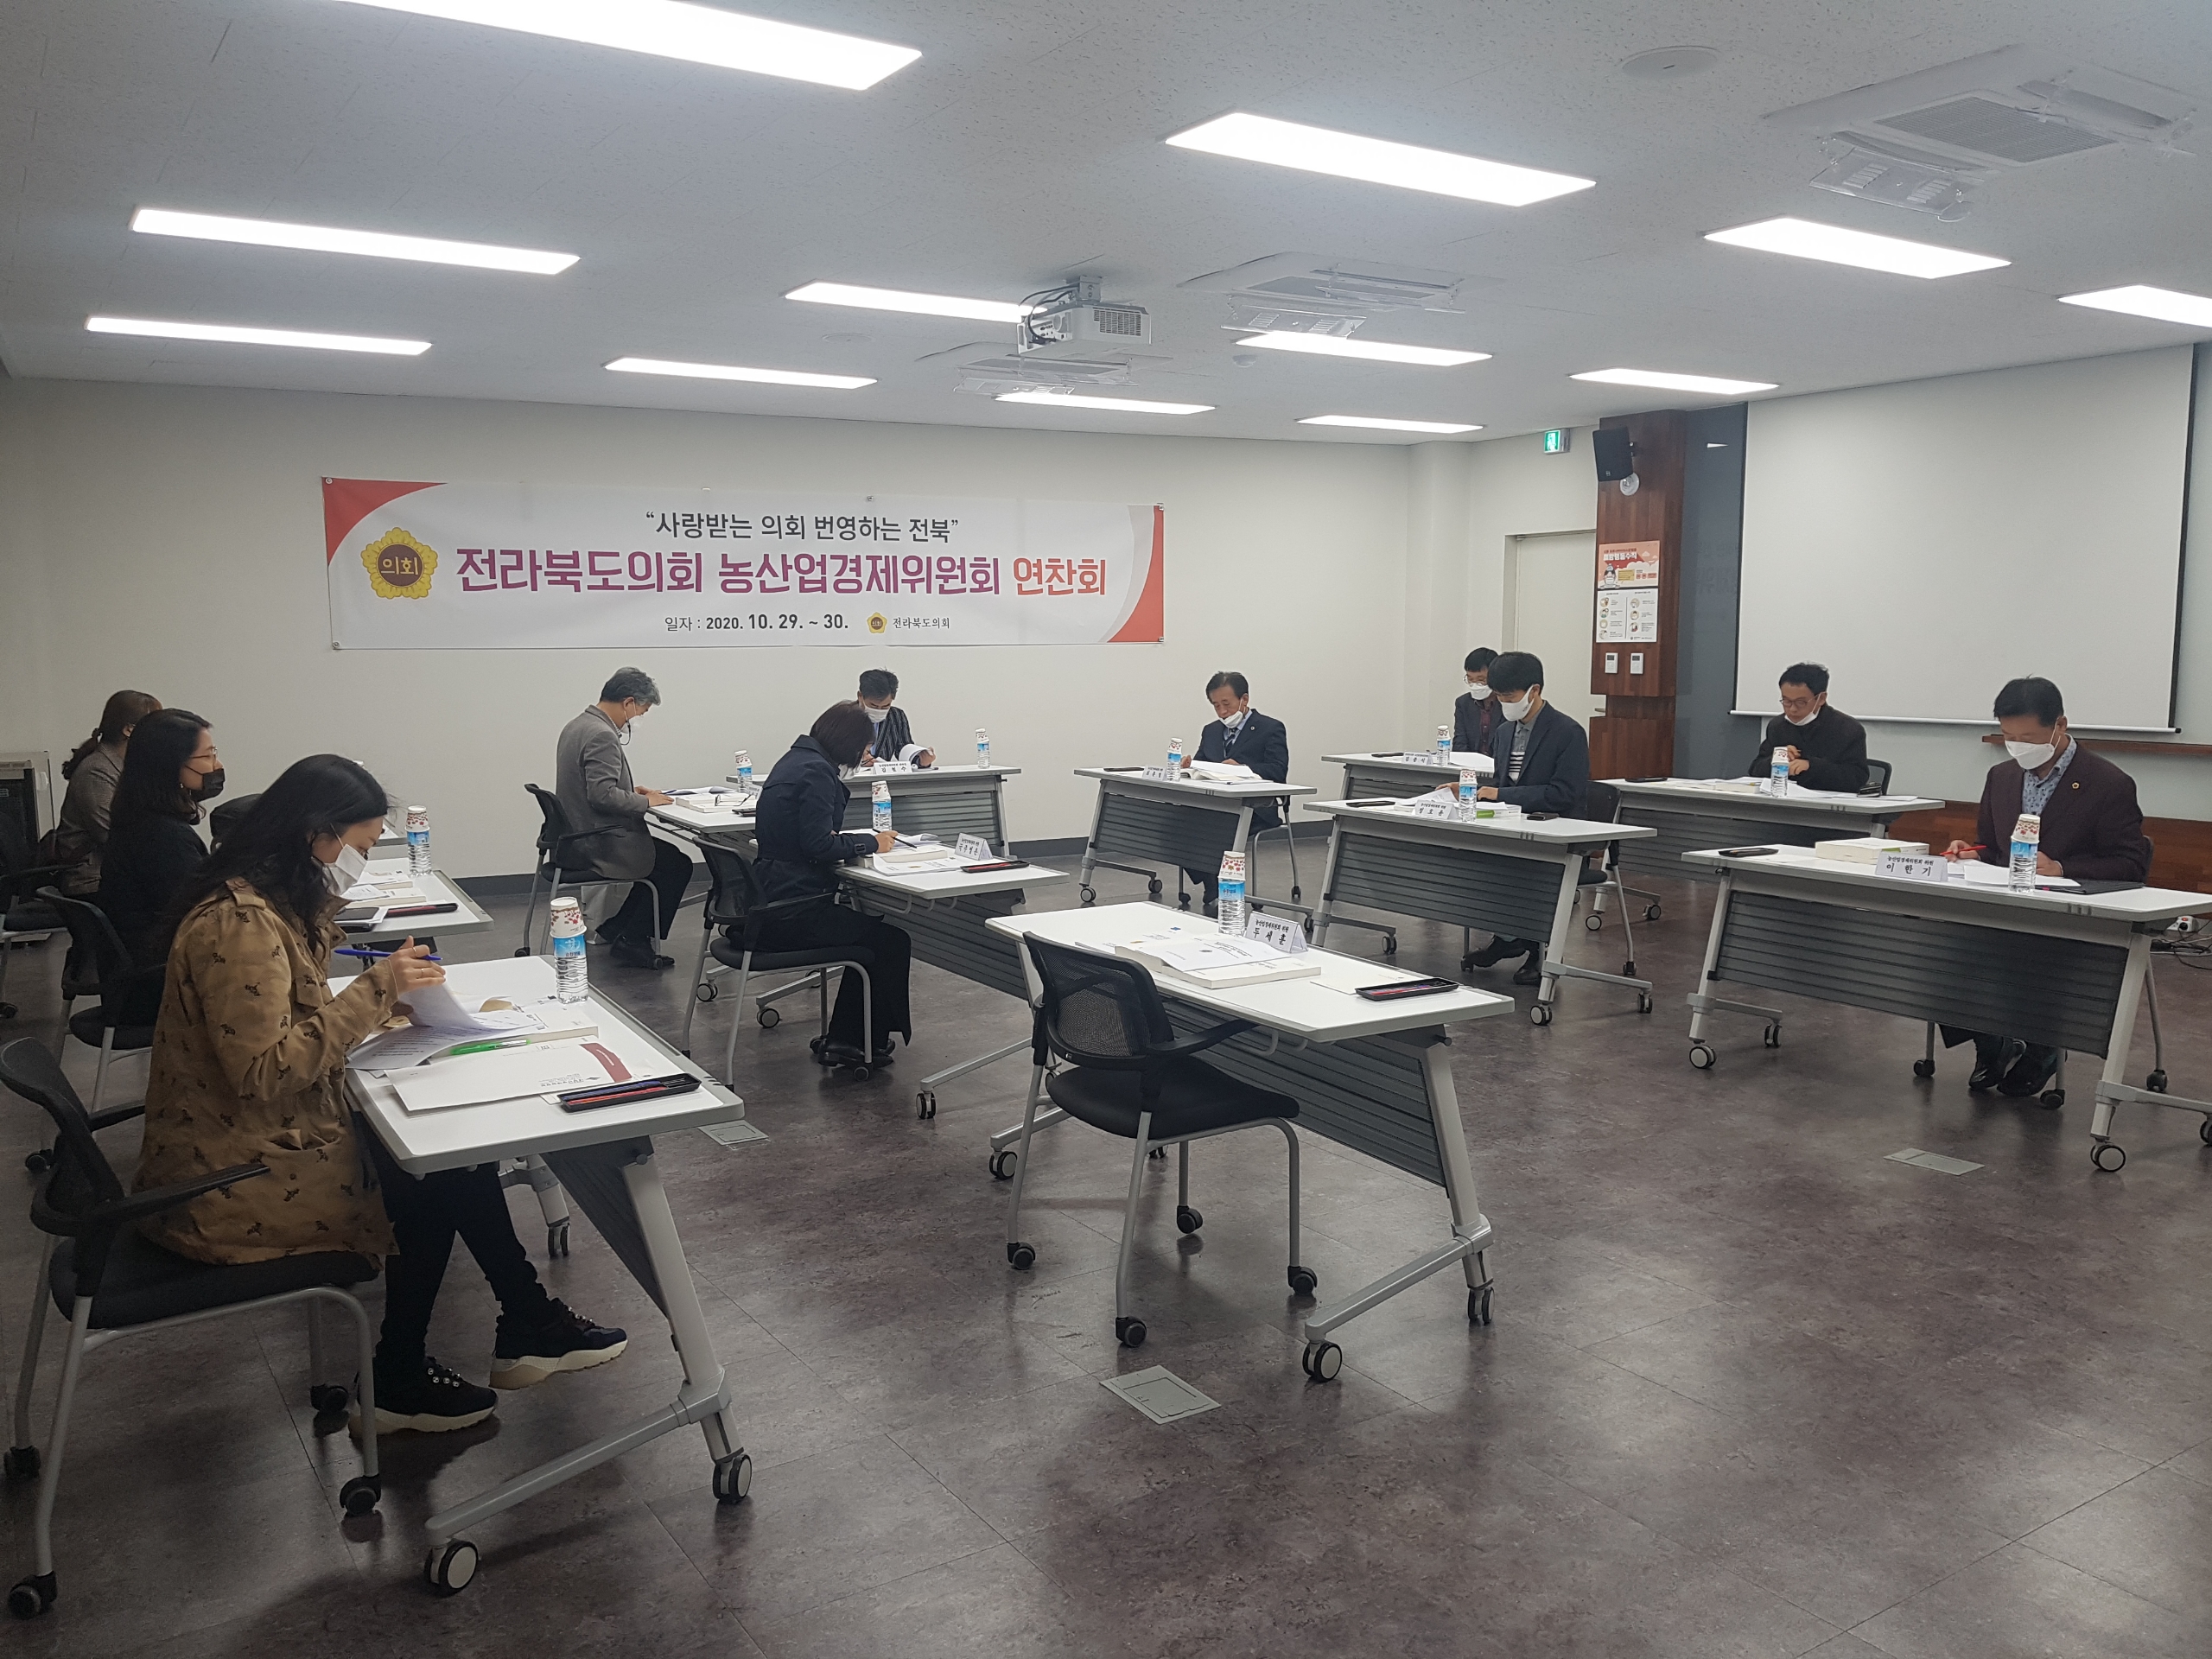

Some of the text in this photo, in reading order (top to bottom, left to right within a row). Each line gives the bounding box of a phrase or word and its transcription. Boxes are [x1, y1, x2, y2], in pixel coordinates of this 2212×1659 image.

[761, 514, 805, 540] 의회
[814, 517, 901, 542] 번영하는
[381, 556, 419, 575] 의회
[456, 548, 1106, 596] 전라북도의회 농산업경제위원회 연찬회
[664, 616, 692, 632] 일자
[706, 617, 744, 630] 2020.
[748, 614, 773, 629] 10.
[779, 614, 804, 629] 29.
[823, 614, 849, 629] 30.
[893, 617, 950, 630] 전라북도의회
